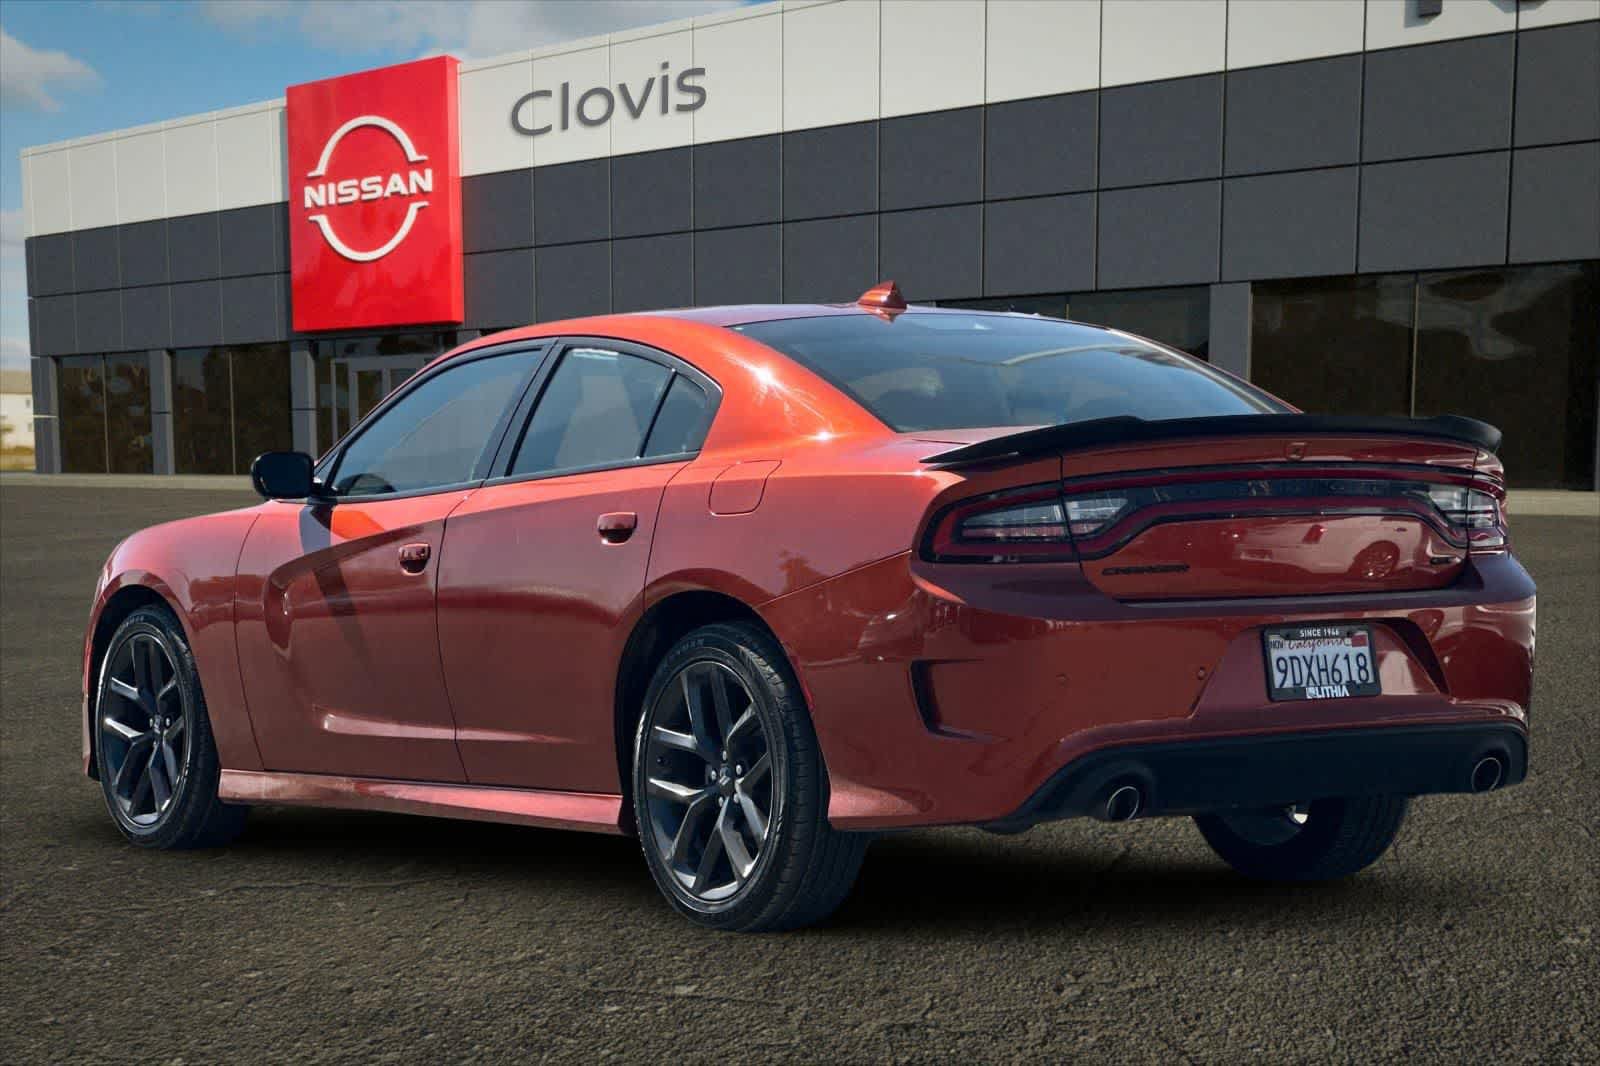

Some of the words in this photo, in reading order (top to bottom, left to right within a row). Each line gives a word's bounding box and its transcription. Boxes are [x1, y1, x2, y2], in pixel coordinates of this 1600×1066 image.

[510, 61, 707, 136] Clovis
[303, 168, 433, 209] NISSAN
[1299, 628, 1321, 638] SINCE
[1276, 652, 1370, 688] 9DXH618
[1315, 685, 1350, 699] LITHIA
